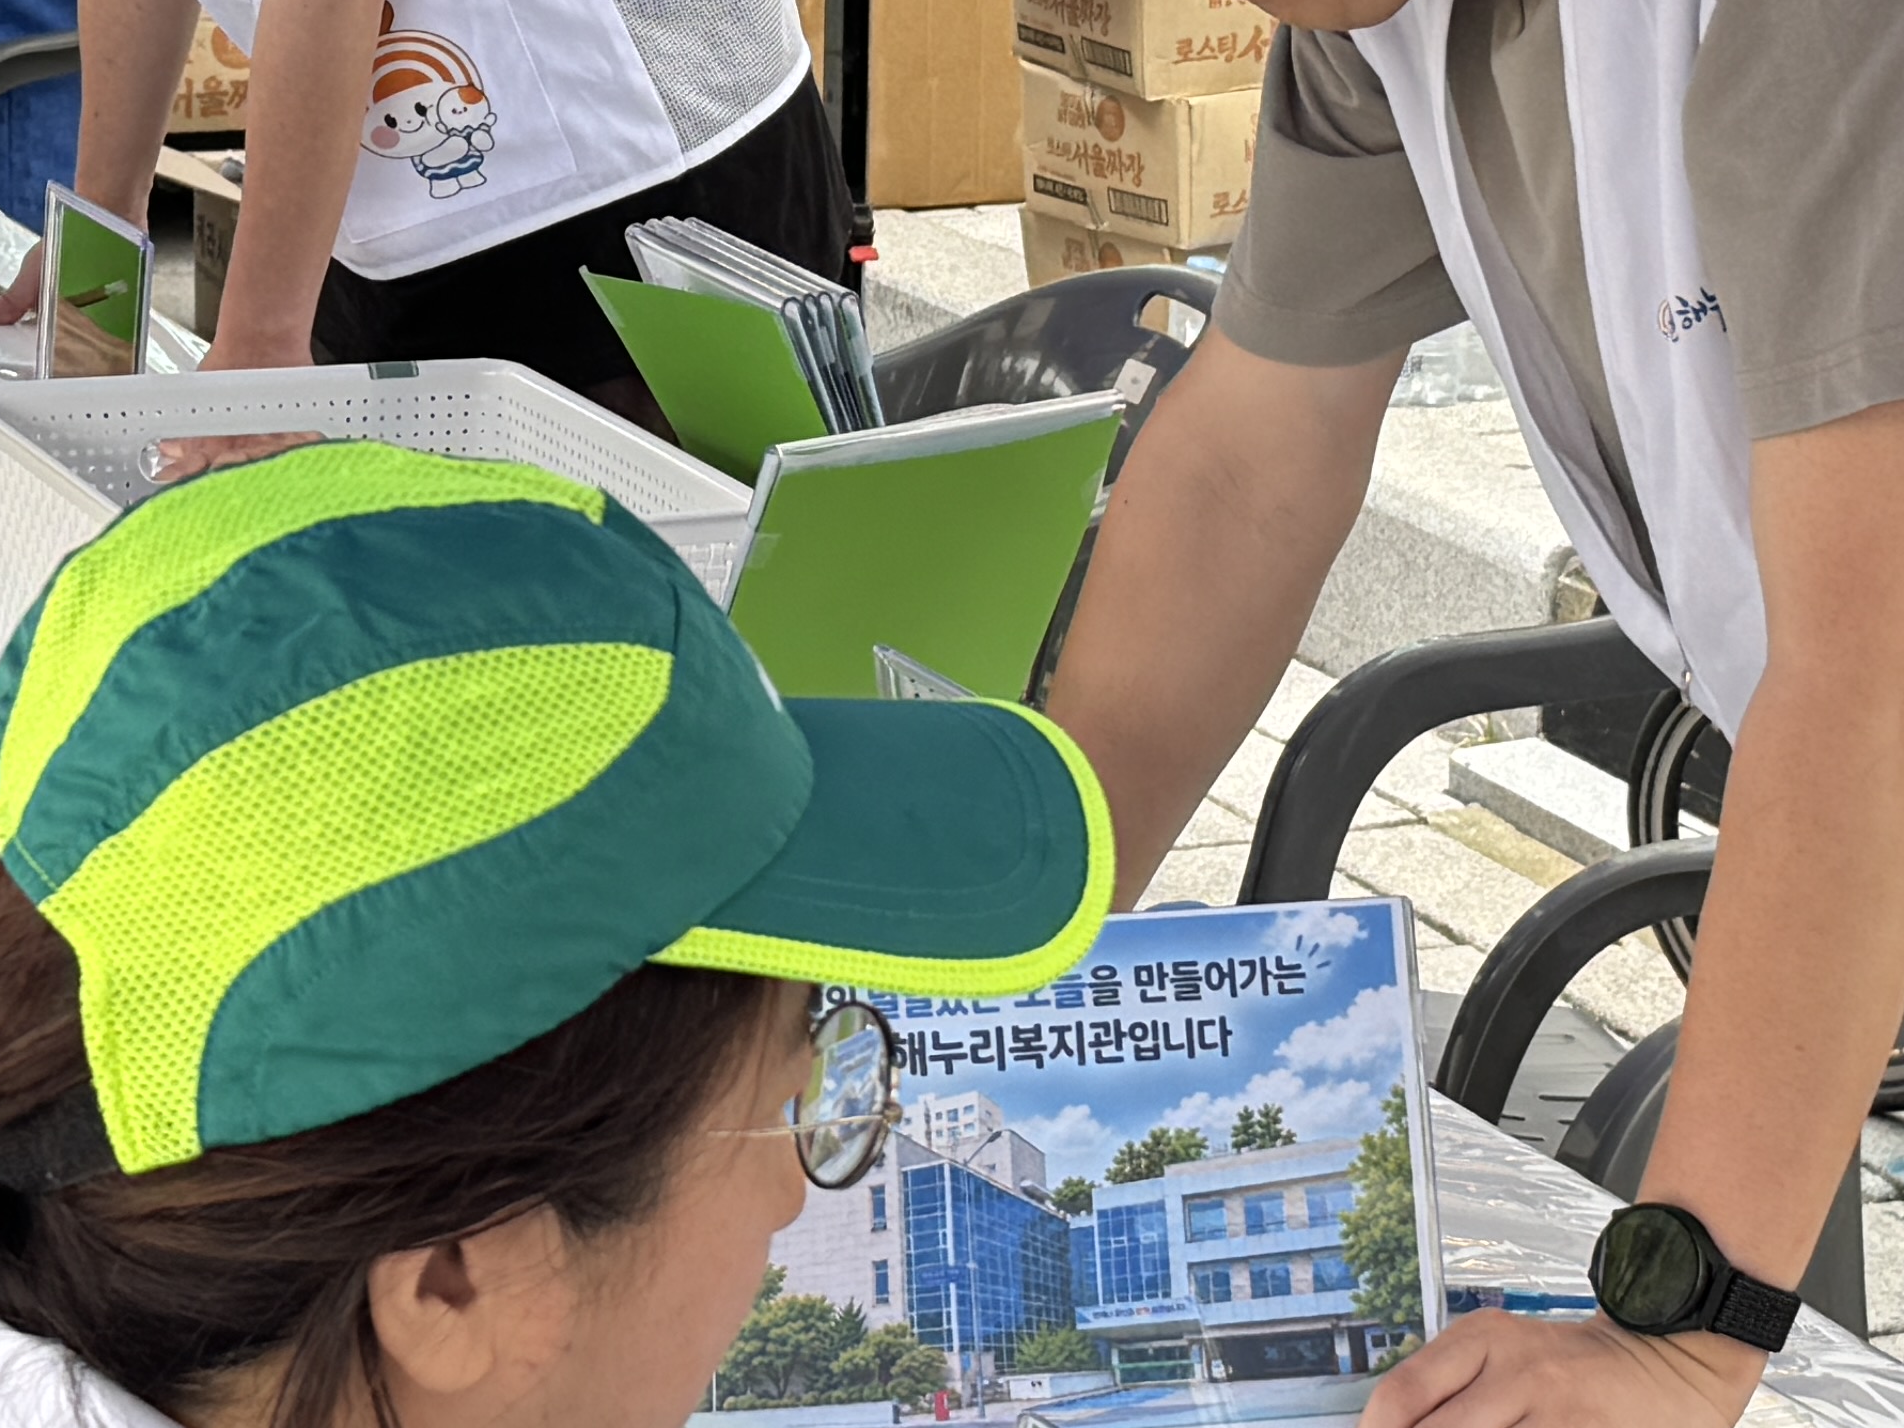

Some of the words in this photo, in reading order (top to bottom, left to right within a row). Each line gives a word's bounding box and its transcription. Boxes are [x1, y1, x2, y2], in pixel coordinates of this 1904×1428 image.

[1173, 32, 1237, 65] 로스팅
[1072, 139, 1145, 188] 서울짜장
[1675, 285, 1728, 333] 해누
[1133, 954, 1308, 1006] 만들어가는
[893, 1015, 1234, 1077] 해누리복지관입니다
